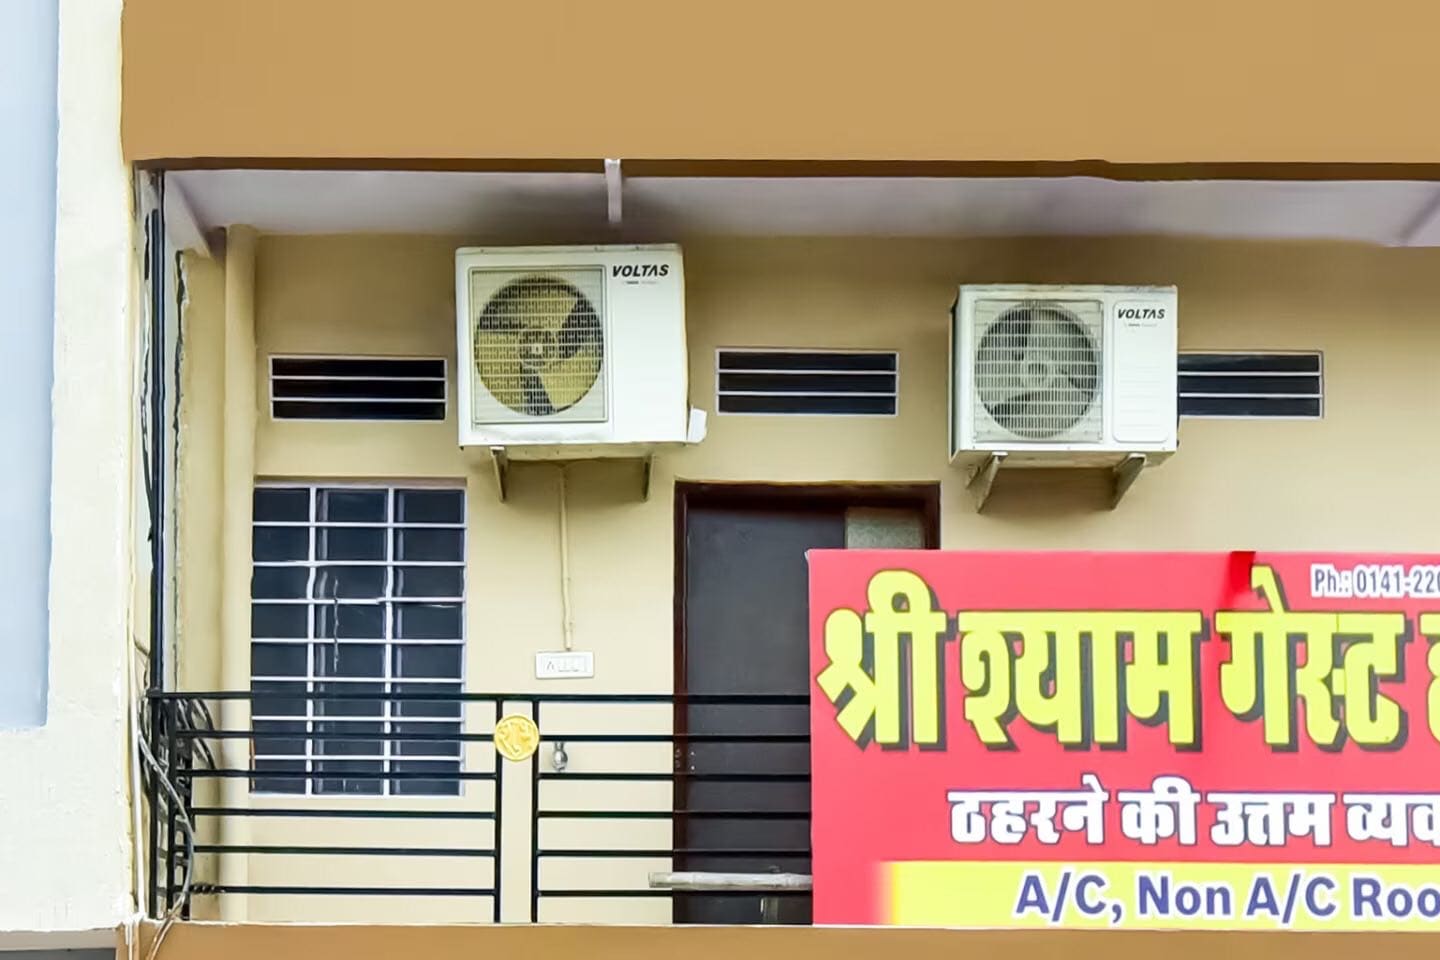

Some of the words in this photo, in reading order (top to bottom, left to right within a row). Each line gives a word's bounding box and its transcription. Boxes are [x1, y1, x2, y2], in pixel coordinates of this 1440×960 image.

[613, 264, 669, 277] VOLTAS
[1118, 309, 1165, 319] VOLTAS
[816, 568, 952, 748] श्री
[957, 610, 1206, 750] श्याम
[1215, 565, 1411, 751] गेस्ट
[946, 773, 1109, 844] ठहरने
[1117, 775, 1201, 845] की
[1206, 792, 1335, 847] उत्तम
[1016, 874, 1122, 923] A/C,
[1138, 875, 1231, 915] Non
[1246, 873, 1336, 923] A/C
